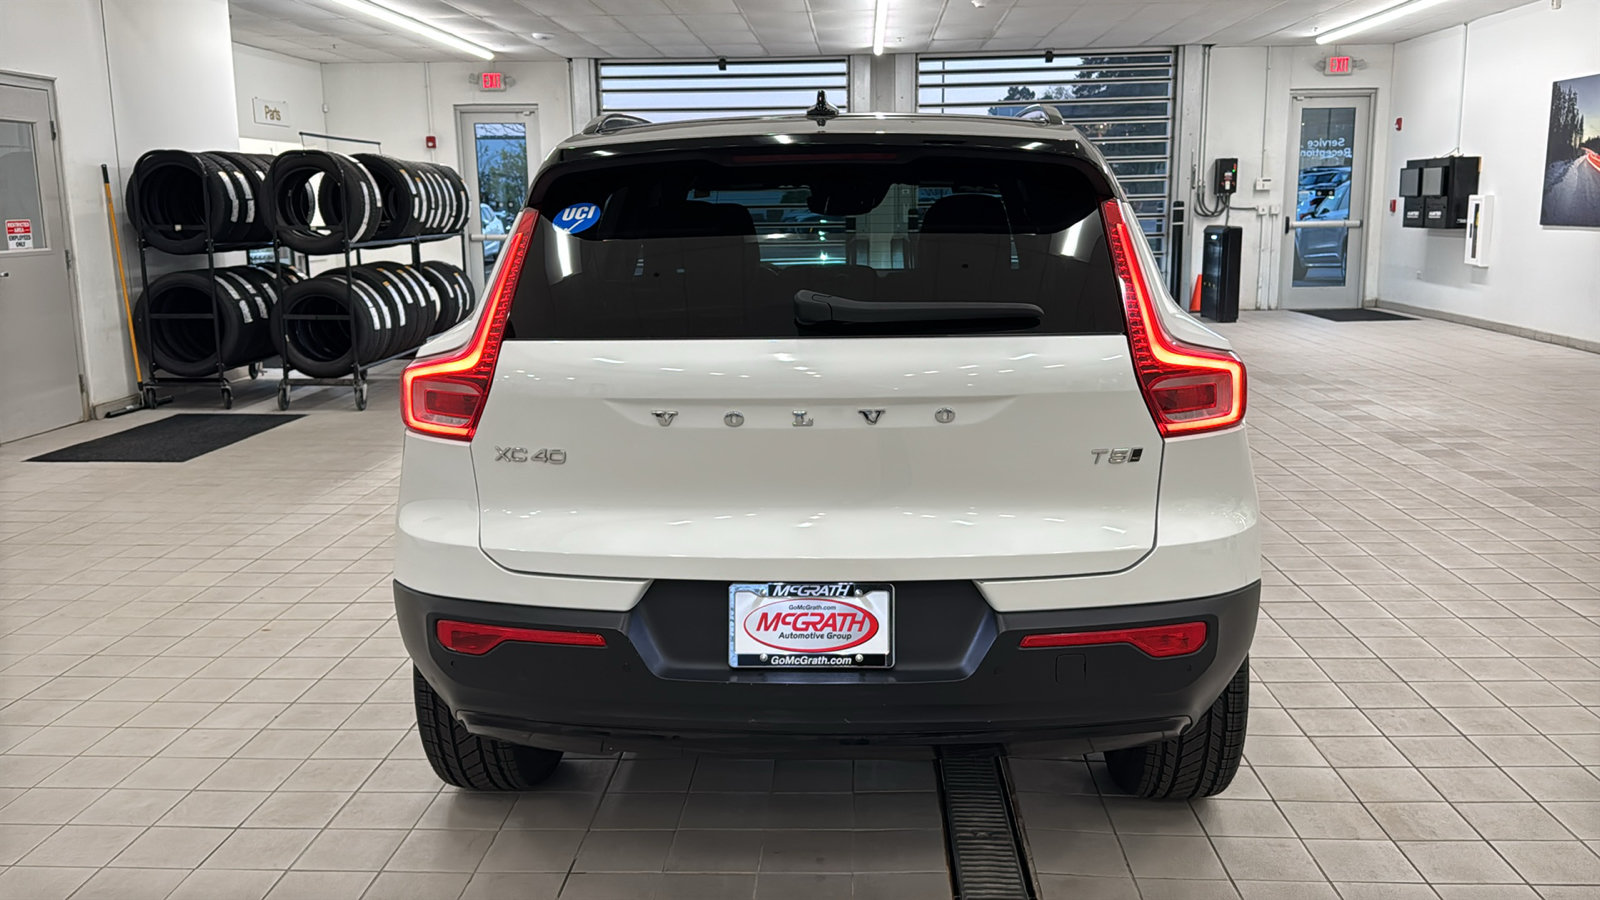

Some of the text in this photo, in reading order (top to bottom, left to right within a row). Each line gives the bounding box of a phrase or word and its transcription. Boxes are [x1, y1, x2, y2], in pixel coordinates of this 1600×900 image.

[1329, 56, 1350, 73] EXIT
[482, 72, 502, 88] EXIT
[264, 104, 281, 121] Parts
[562, 205, 597, 221] UCI
[651, 407, 956, 428] VOLVO
[778, 631, 852, 641] Automotive Group
[770, 655, 852, 666] GoMcGrath.com
